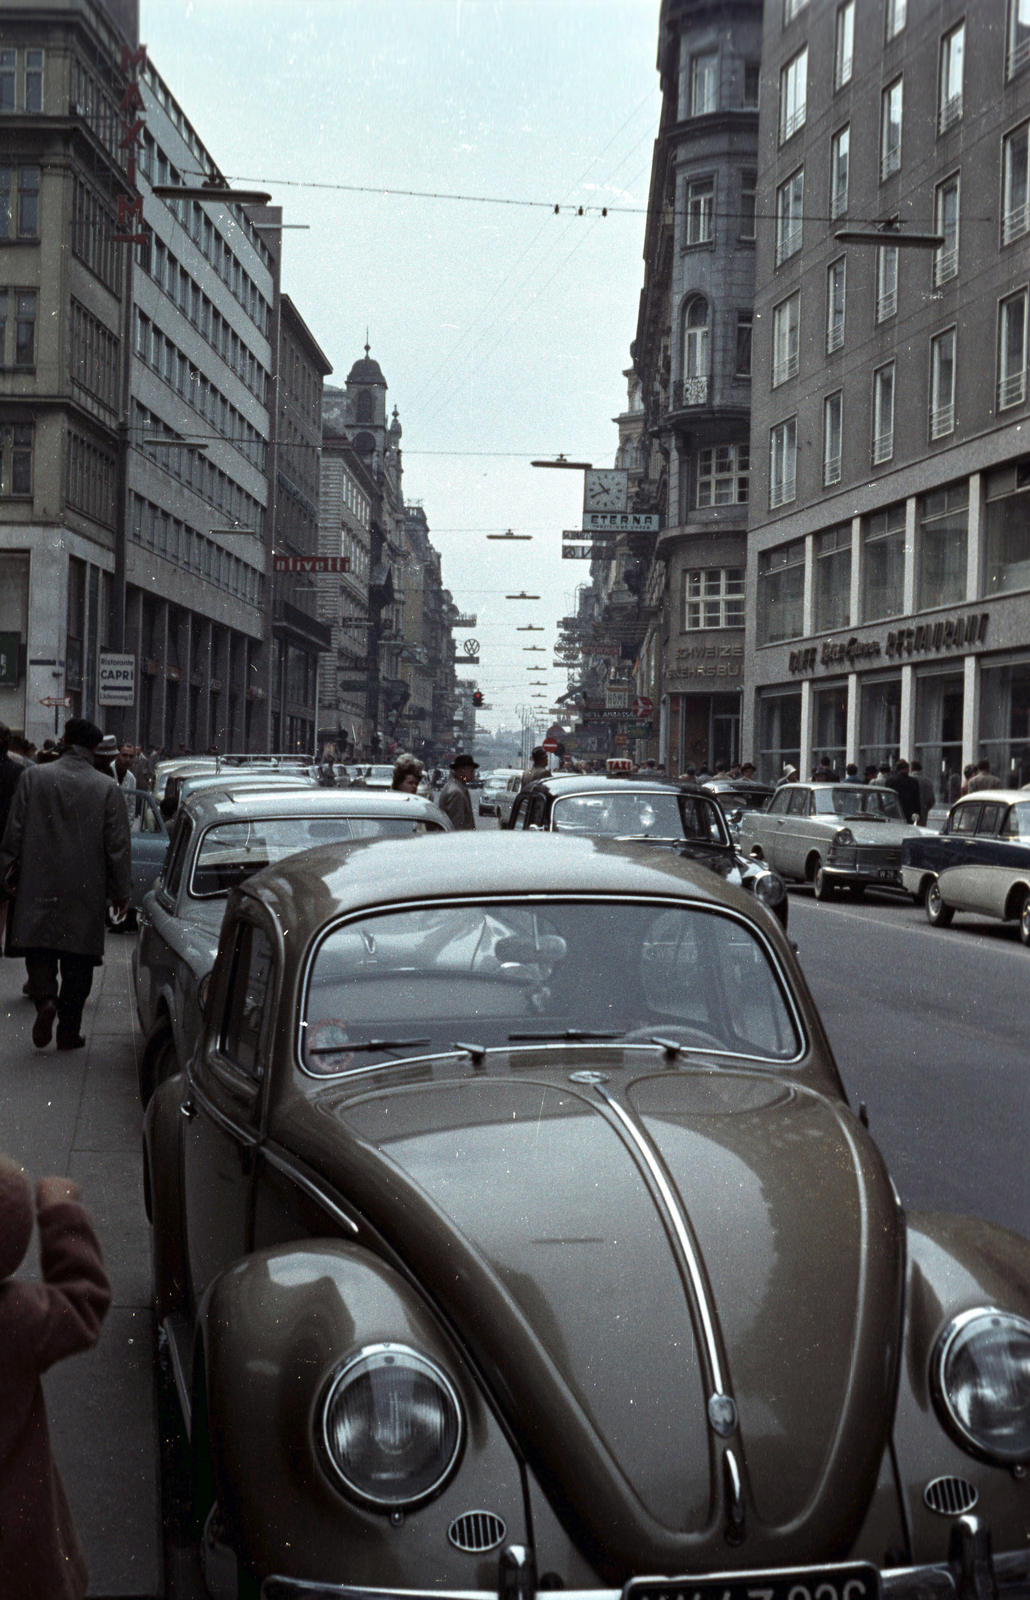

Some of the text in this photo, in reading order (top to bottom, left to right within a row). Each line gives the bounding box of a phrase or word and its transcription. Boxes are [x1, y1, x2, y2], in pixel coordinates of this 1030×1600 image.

[118, 43, 147, 226] MAXIM
[591, 514, 653, 525] ETERNA
[276, 556, 350, 571] olivetti
[885, 613, 989, 659] RESTAURANT
[464, 638, 480, 655] VW
[675, 644, 744, 660] SCHWEIZE
[100, 658, 134, 666] Ristorante
[100, 669, 134, 681] CAPRI
[608, 760, 632, 771] TAXI
